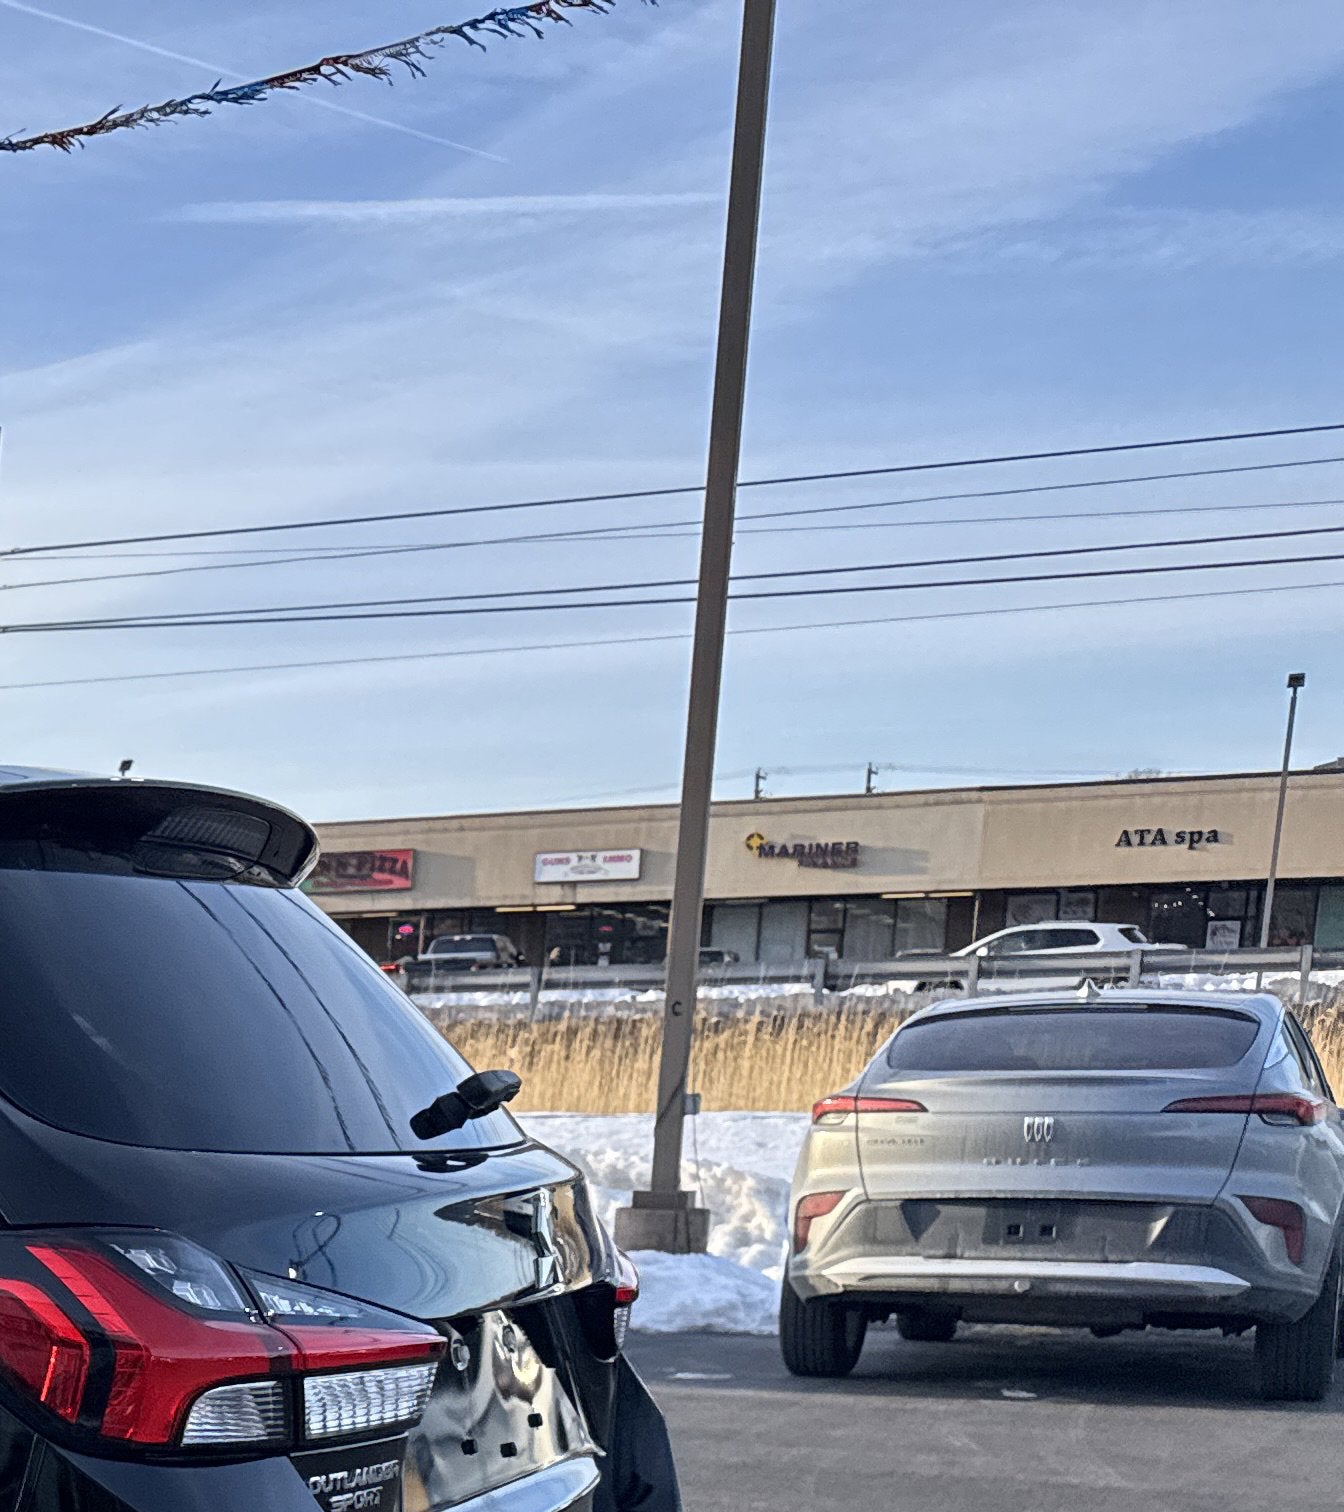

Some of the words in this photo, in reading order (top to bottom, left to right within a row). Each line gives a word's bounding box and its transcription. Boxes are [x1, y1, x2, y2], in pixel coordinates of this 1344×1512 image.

[1114, 827, 1169, 847] ATA
[1174, 829, 1219, 851] spa
[309, 1459, 400, 1495] OUTLANDER
